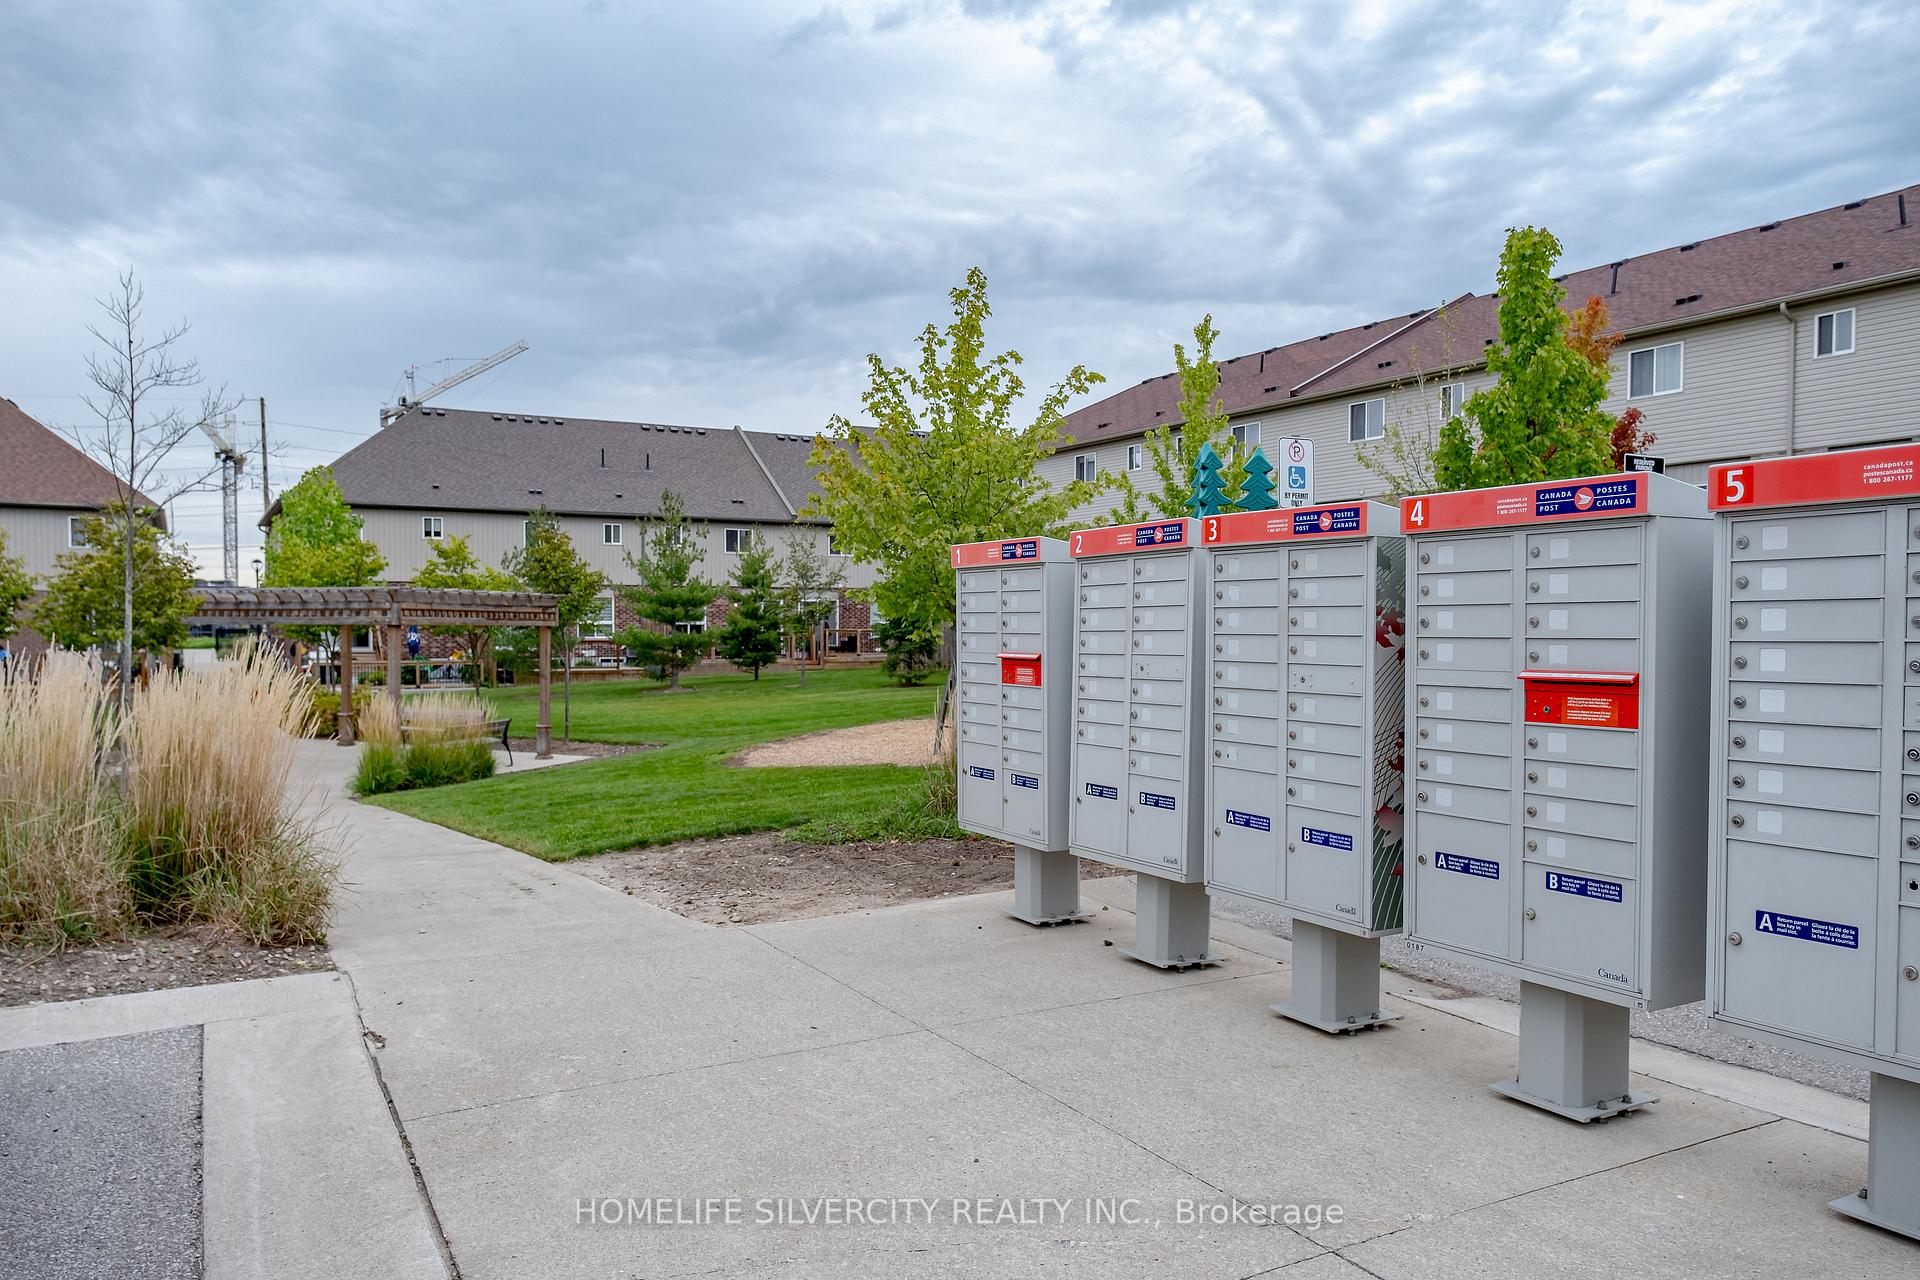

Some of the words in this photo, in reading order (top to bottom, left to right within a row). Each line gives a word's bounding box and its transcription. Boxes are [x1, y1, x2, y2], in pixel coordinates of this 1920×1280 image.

[1864, 461, 1913, 469] canadapost.ca
[1864, 468, 1913, 478] postescanada.ca
[1726, 470, 1744, 502] 5
[1540, 491, 1572, 499] CANADA
[1597, 485, 1627, 494] POSTES
[1596, 498, 1631, 506] CANADA
[1411, 501, 1424, 526] 4
[1208, 519, 1217, 541] 3
[1076, 535, 1082, 553] 2
[956, 548, 960, 564] 1
[1087, 784, 1092, 794] A
[1141, 794, 1145, 803] B
[1228, 812, 1234, 823] A
[1304, 829, 1309, 840] B
[1438, 854, 1446, 868] A
[1550, 874, 1558, 888] B
[1336, 904, 1356, 915] Canada
[1760, 914, 1773, 931] A
[1777, 916, 1793, 924] Return
[1812, 922, 1828, 930] Glissez
[1407, 942, 1424, 951] 0187
[1598, 968, 1628, 983] Canada
